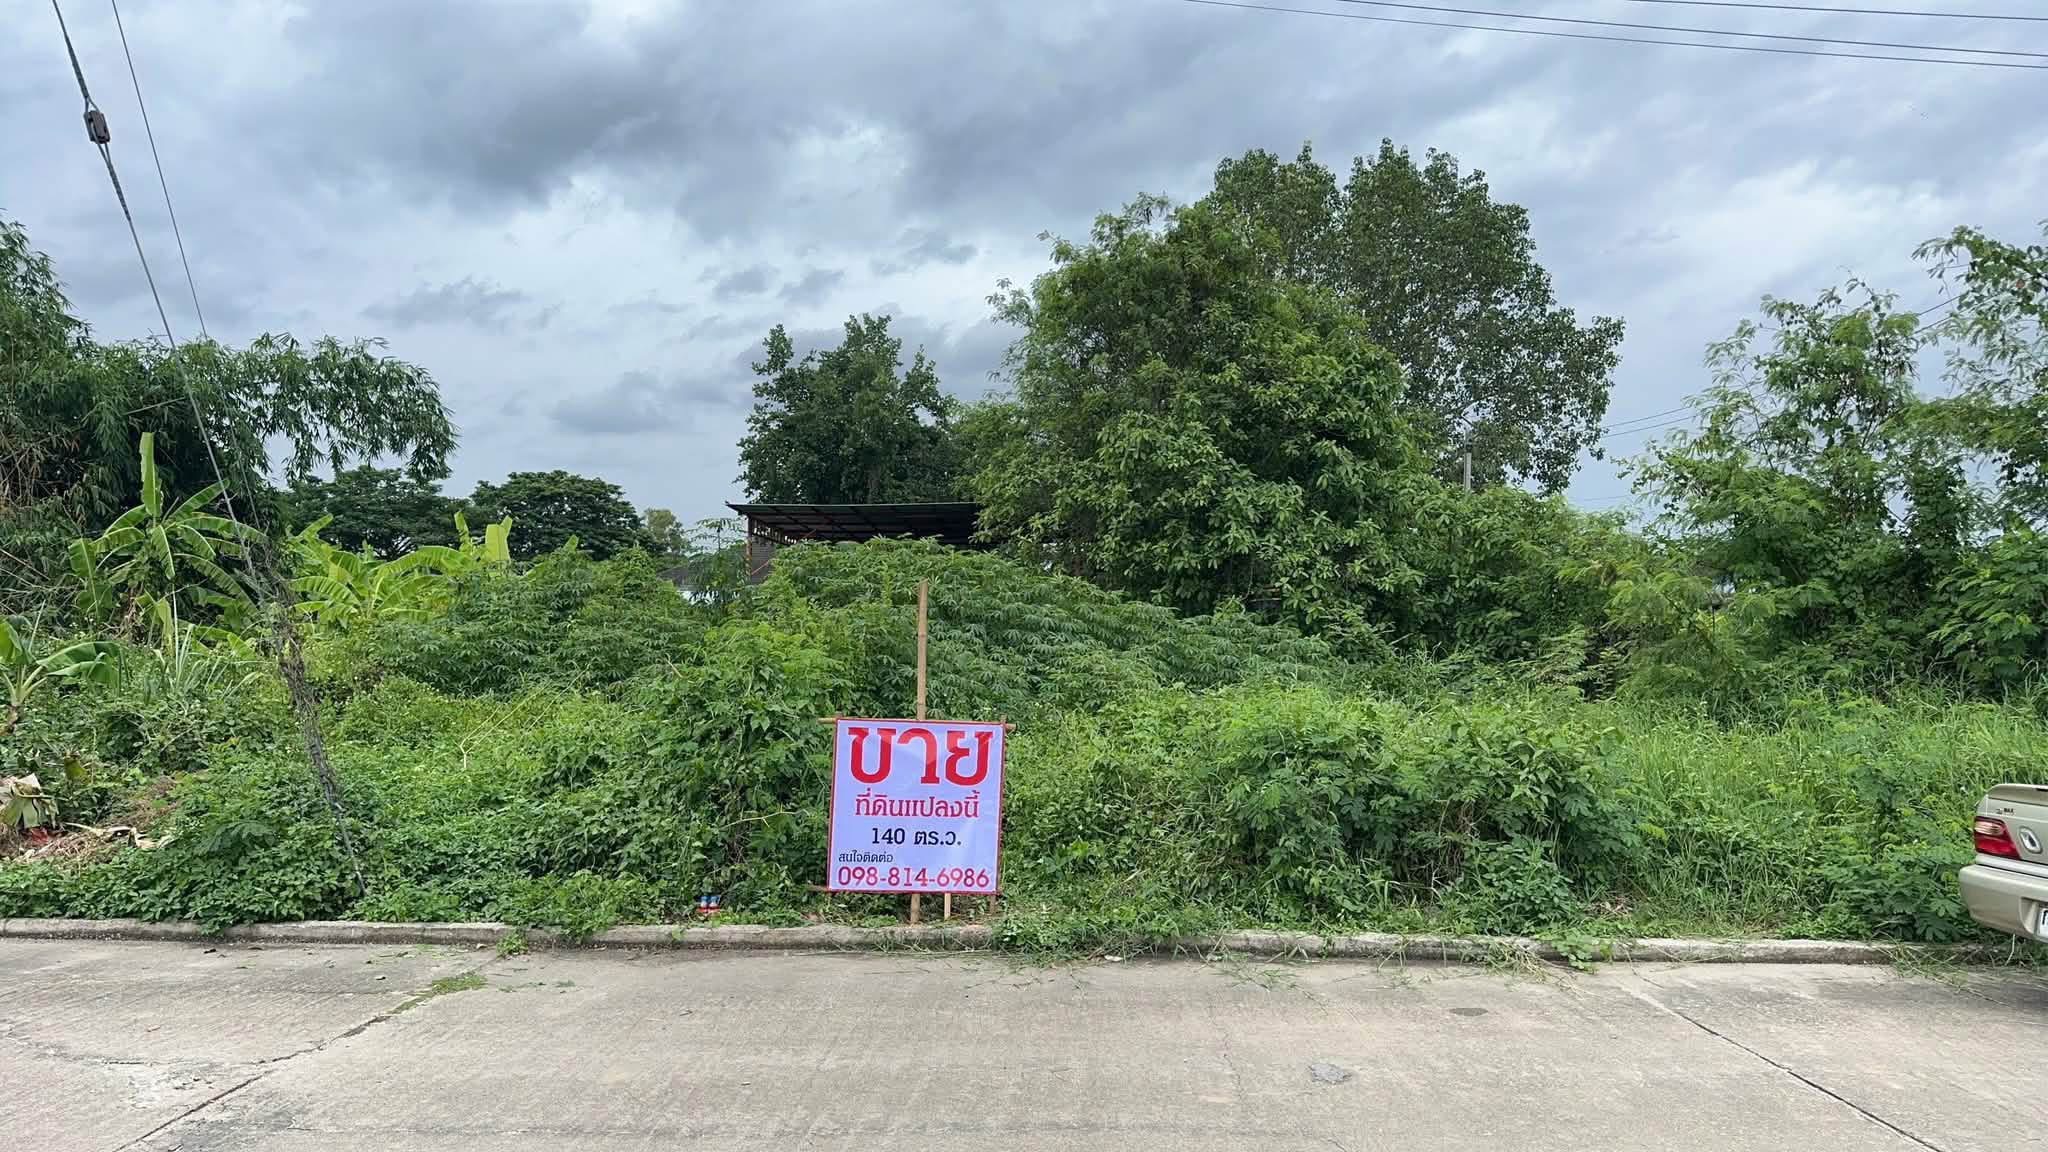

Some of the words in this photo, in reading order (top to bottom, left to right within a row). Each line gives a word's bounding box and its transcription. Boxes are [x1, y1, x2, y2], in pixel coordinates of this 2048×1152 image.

[848, 727, 993, 786] ขาย
[855, 788, 980, 818] ที่ดินแปลงนี้
[872, 828, 905, 845] 140
[914, 830, 961, 845] ตร.ว.
[838, 850, 893, 863] สนใจติดต่อ
[838, 866, 989, 887] 098-814-6986
